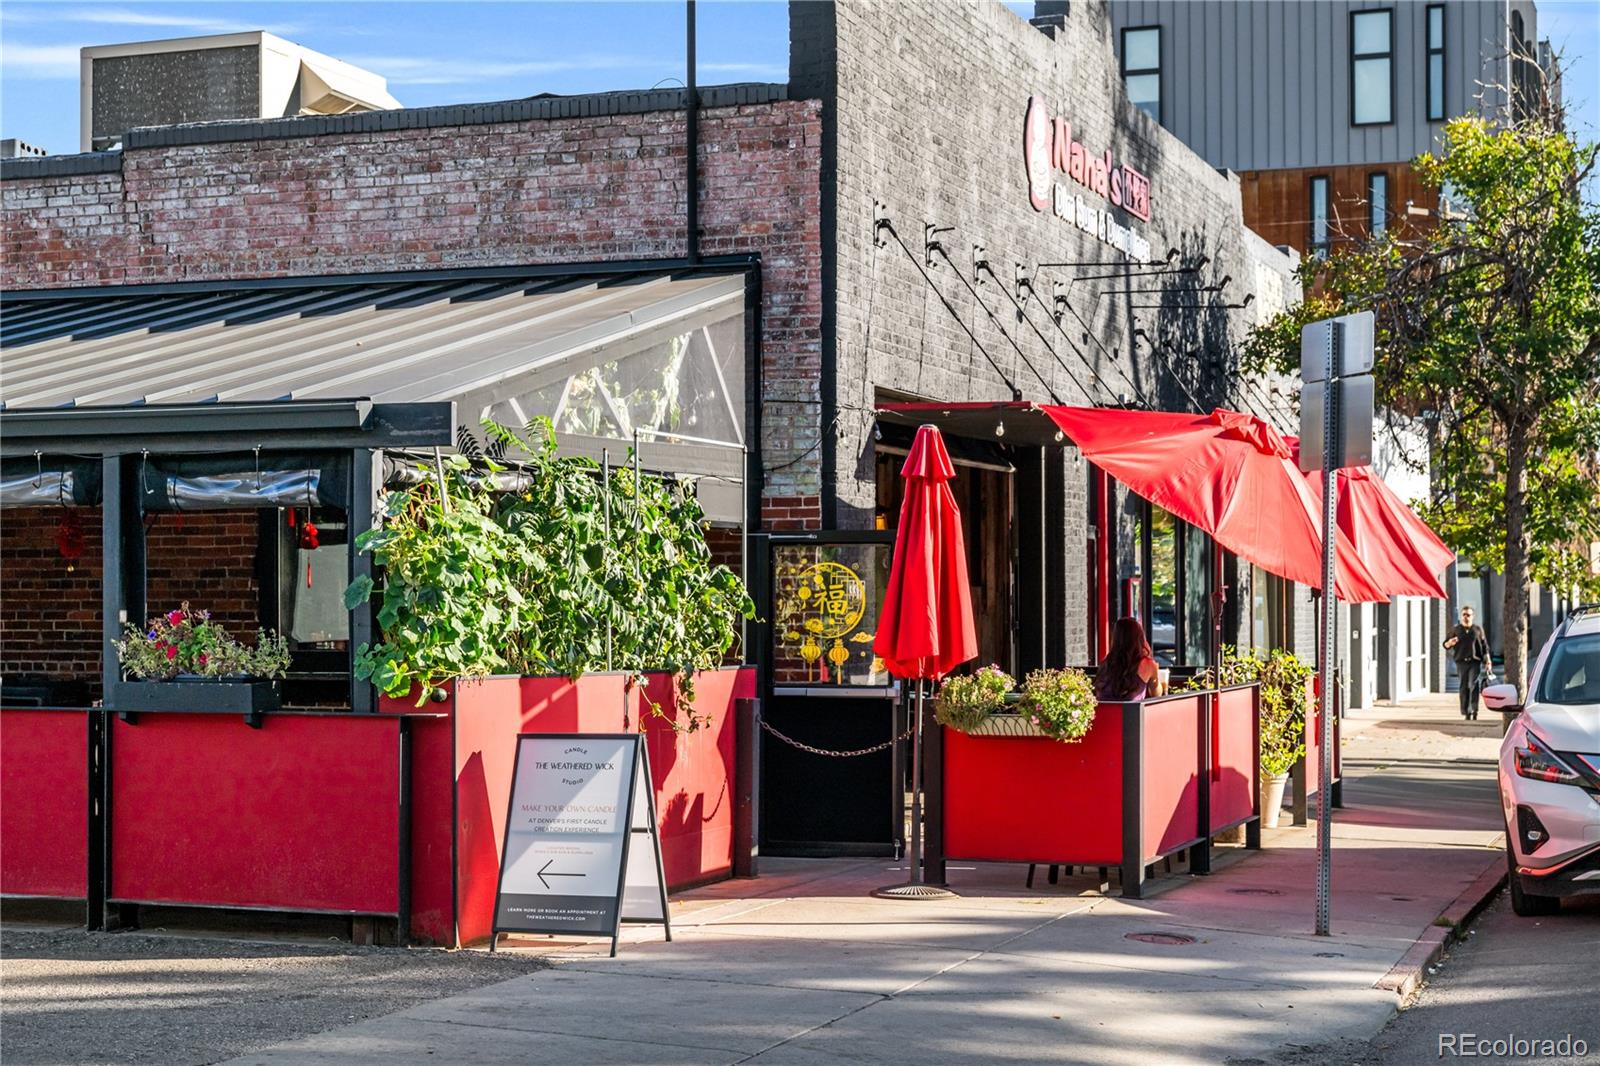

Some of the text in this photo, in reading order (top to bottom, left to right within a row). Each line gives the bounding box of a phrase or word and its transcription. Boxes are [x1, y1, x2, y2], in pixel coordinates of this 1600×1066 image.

[1053, 116, 1122, 206] Nana's
[813, 582, 848, 615] 福
[564, 747, 588, 755] CANDLE
[535, 762, 614, 770] THE WEATHERED WICK
[521, 804, 543, 812] MAKE
[544, 804, 564, 812] YOUR
[587, 805, 616, 813] CANDLE
